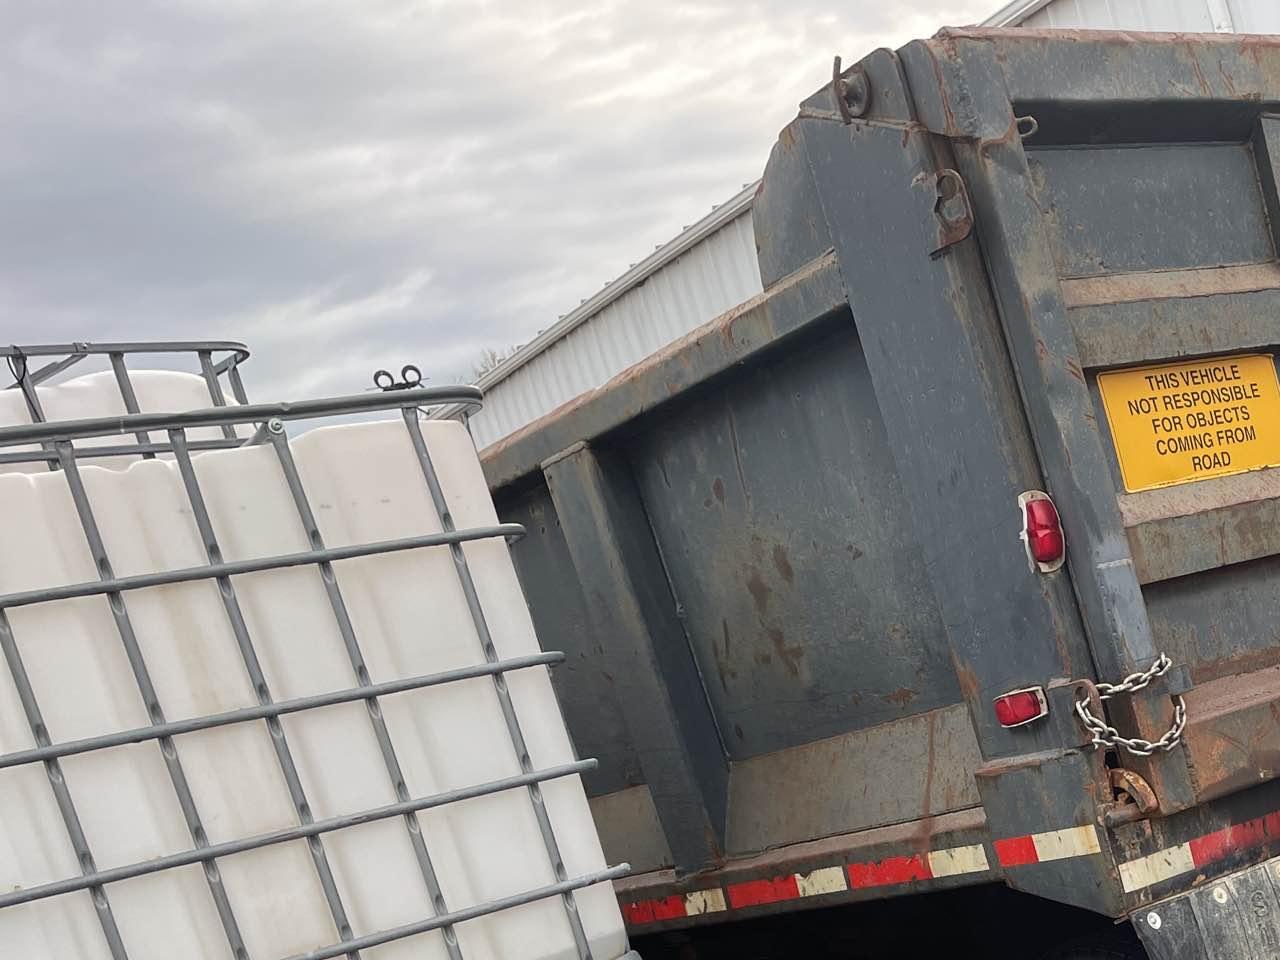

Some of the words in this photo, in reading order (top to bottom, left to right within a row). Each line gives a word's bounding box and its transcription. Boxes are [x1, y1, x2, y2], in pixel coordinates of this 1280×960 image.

[1145, 372, 1180, 391] THIS
[1179, 365, 1241, 387] VEHICLE
[1128, 397, 1158, 415] NOT
[1164, 383, 1261, 410] RESPONSIBLE
[1152, 416, 1183, 434] FOR
[1186, 405, 1250, 429] OBJECTS
[1156, 433, 1214, 455] COMING
[1216, 425, 1256, 446] FROM
[1192, 451, 1231, 471] ROAD
